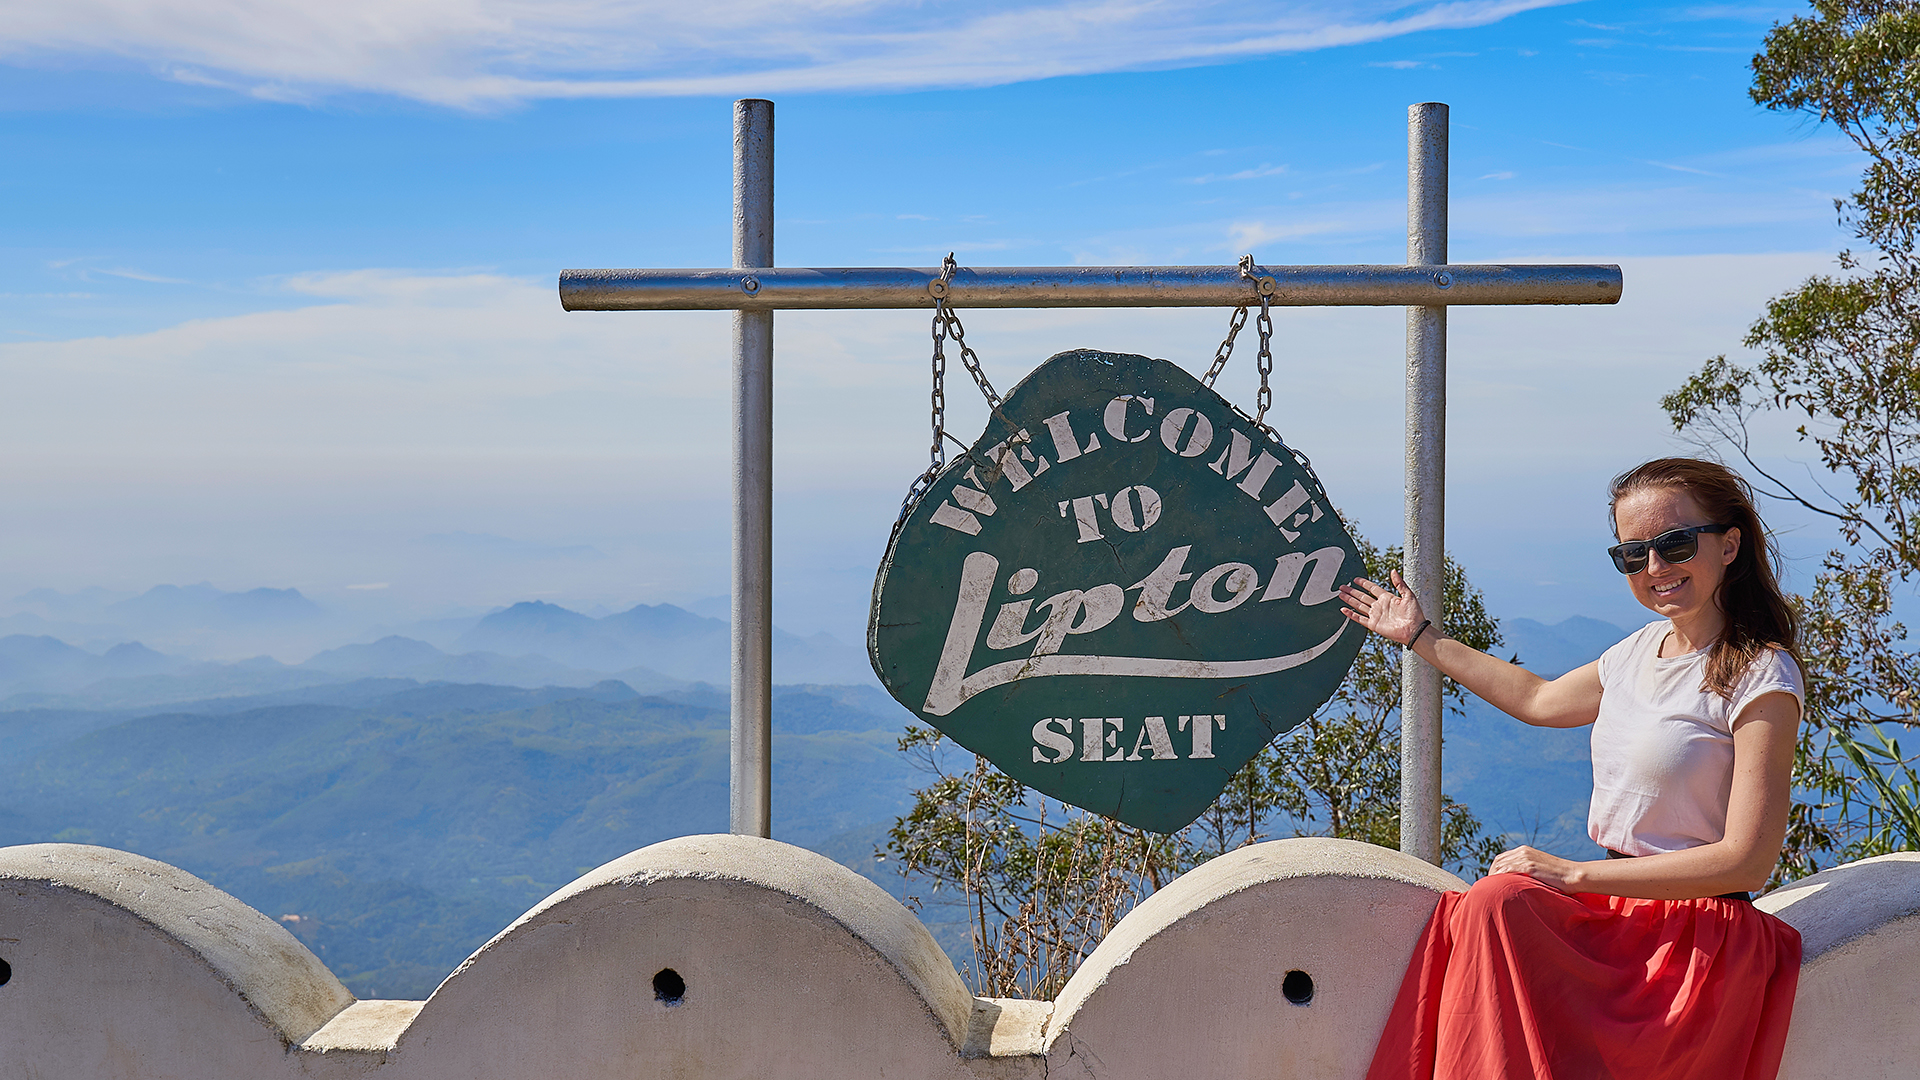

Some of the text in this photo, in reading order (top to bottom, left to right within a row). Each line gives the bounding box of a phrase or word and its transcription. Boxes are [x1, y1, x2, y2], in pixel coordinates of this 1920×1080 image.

[929, 394, 1324, 543] WELCOME
[1058, 485, 1162, 544] TO
[922, 544, 1352, 717] Lipton
[1031, 714, 1226, 764] SEAT
